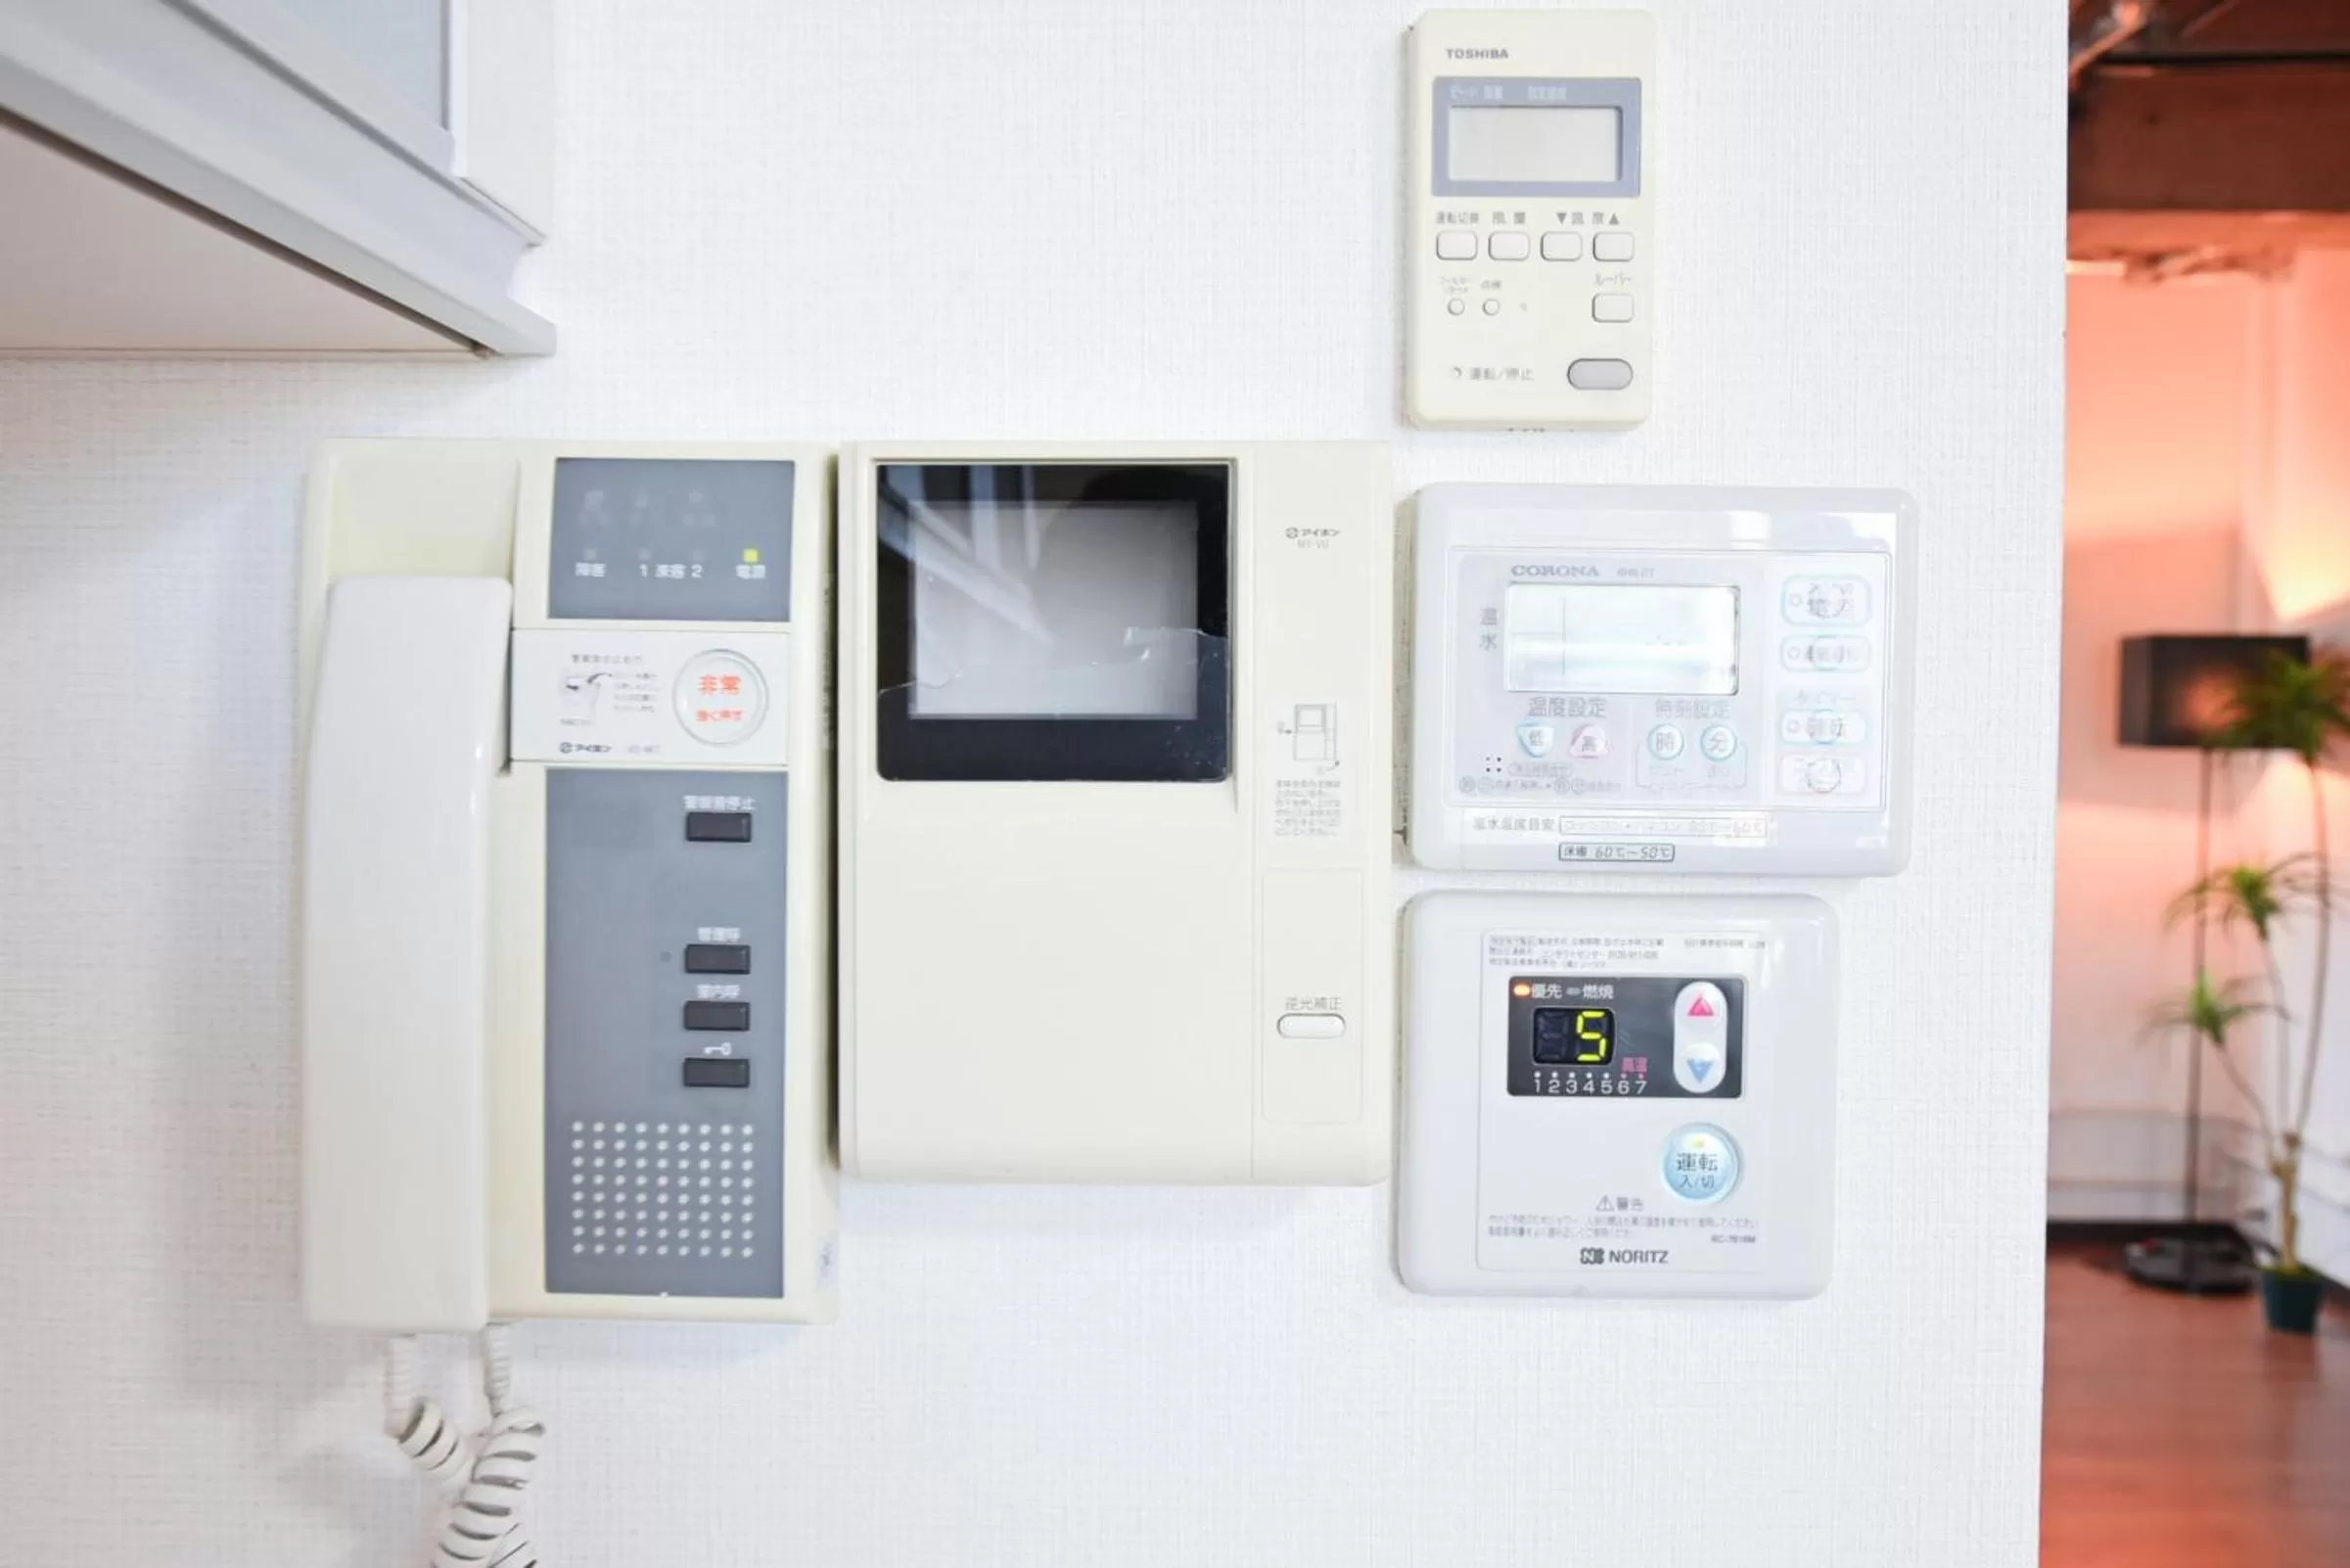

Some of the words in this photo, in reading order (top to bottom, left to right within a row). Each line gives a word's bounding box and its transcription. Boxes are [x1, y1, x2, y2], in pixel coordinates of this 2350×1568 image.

[1446, 48, 1509, 60] TOSHIBA
[639, 564, 649, 577] 1
[691, 564, 704, 578] 2
[1511, 565, 1600, 577] CORONA
[698, 673, 742, 696] 非常
[1527, 696, 1607, 718] 温度設定
[1654, 698, 1730, 719] 時刻設定
[1532, 984, 1563, 999] 優先
[1583, 983, 1615, 1000] 燃焼
[1576, 1010, 1607, 1062] 5
[1676, 1152, 1719, 1173] 運転
[1680, 1175, 1715, 1189] 入/切
[1608, 1250, 1669, 1265] NORITZ
